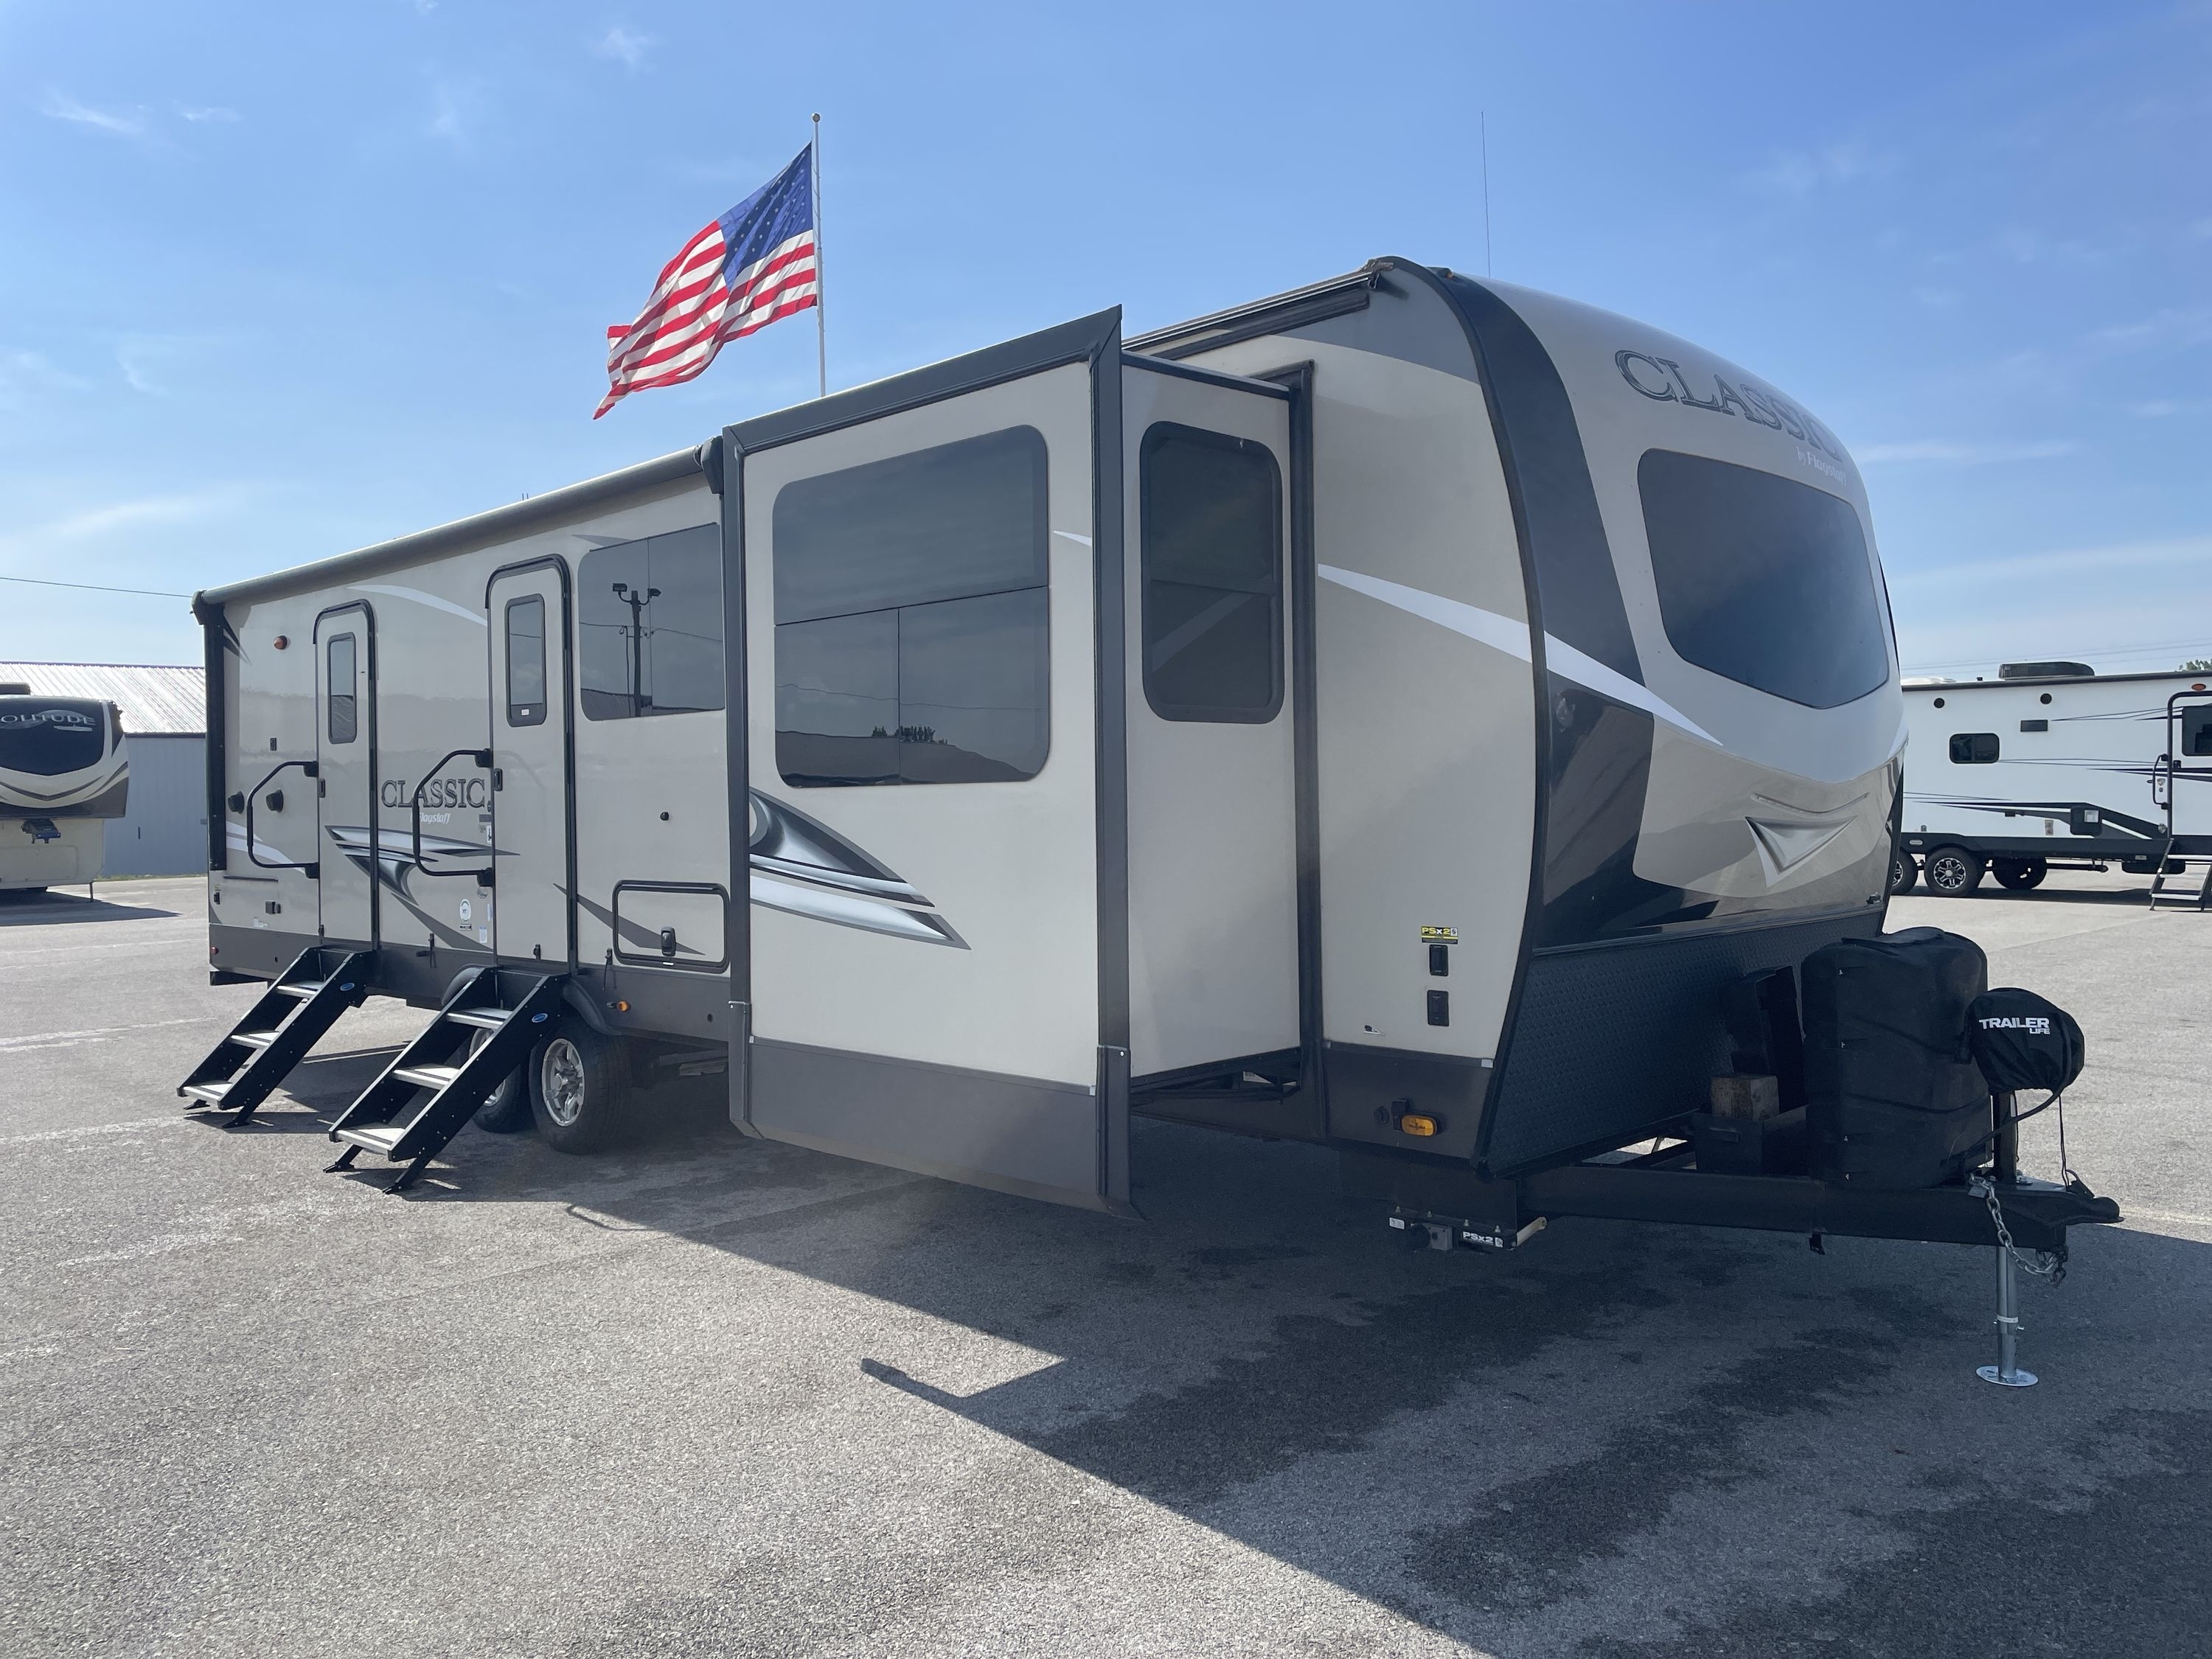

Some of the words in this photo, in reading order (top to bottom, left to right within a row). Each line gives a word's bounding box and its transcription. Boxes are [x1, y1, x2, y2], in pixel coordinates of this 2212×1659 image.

[1614, 349, 1843, 463] CLASSIC
[1795, 445, 1806, 466] by
[0, 714, 97, 726] OLITUDE
[1421, 926, 1451, 936] PSx2
[1978, 1017, 2051, 1030] TRAILER
[1462, 1231, 1494, 1243] PSx2
